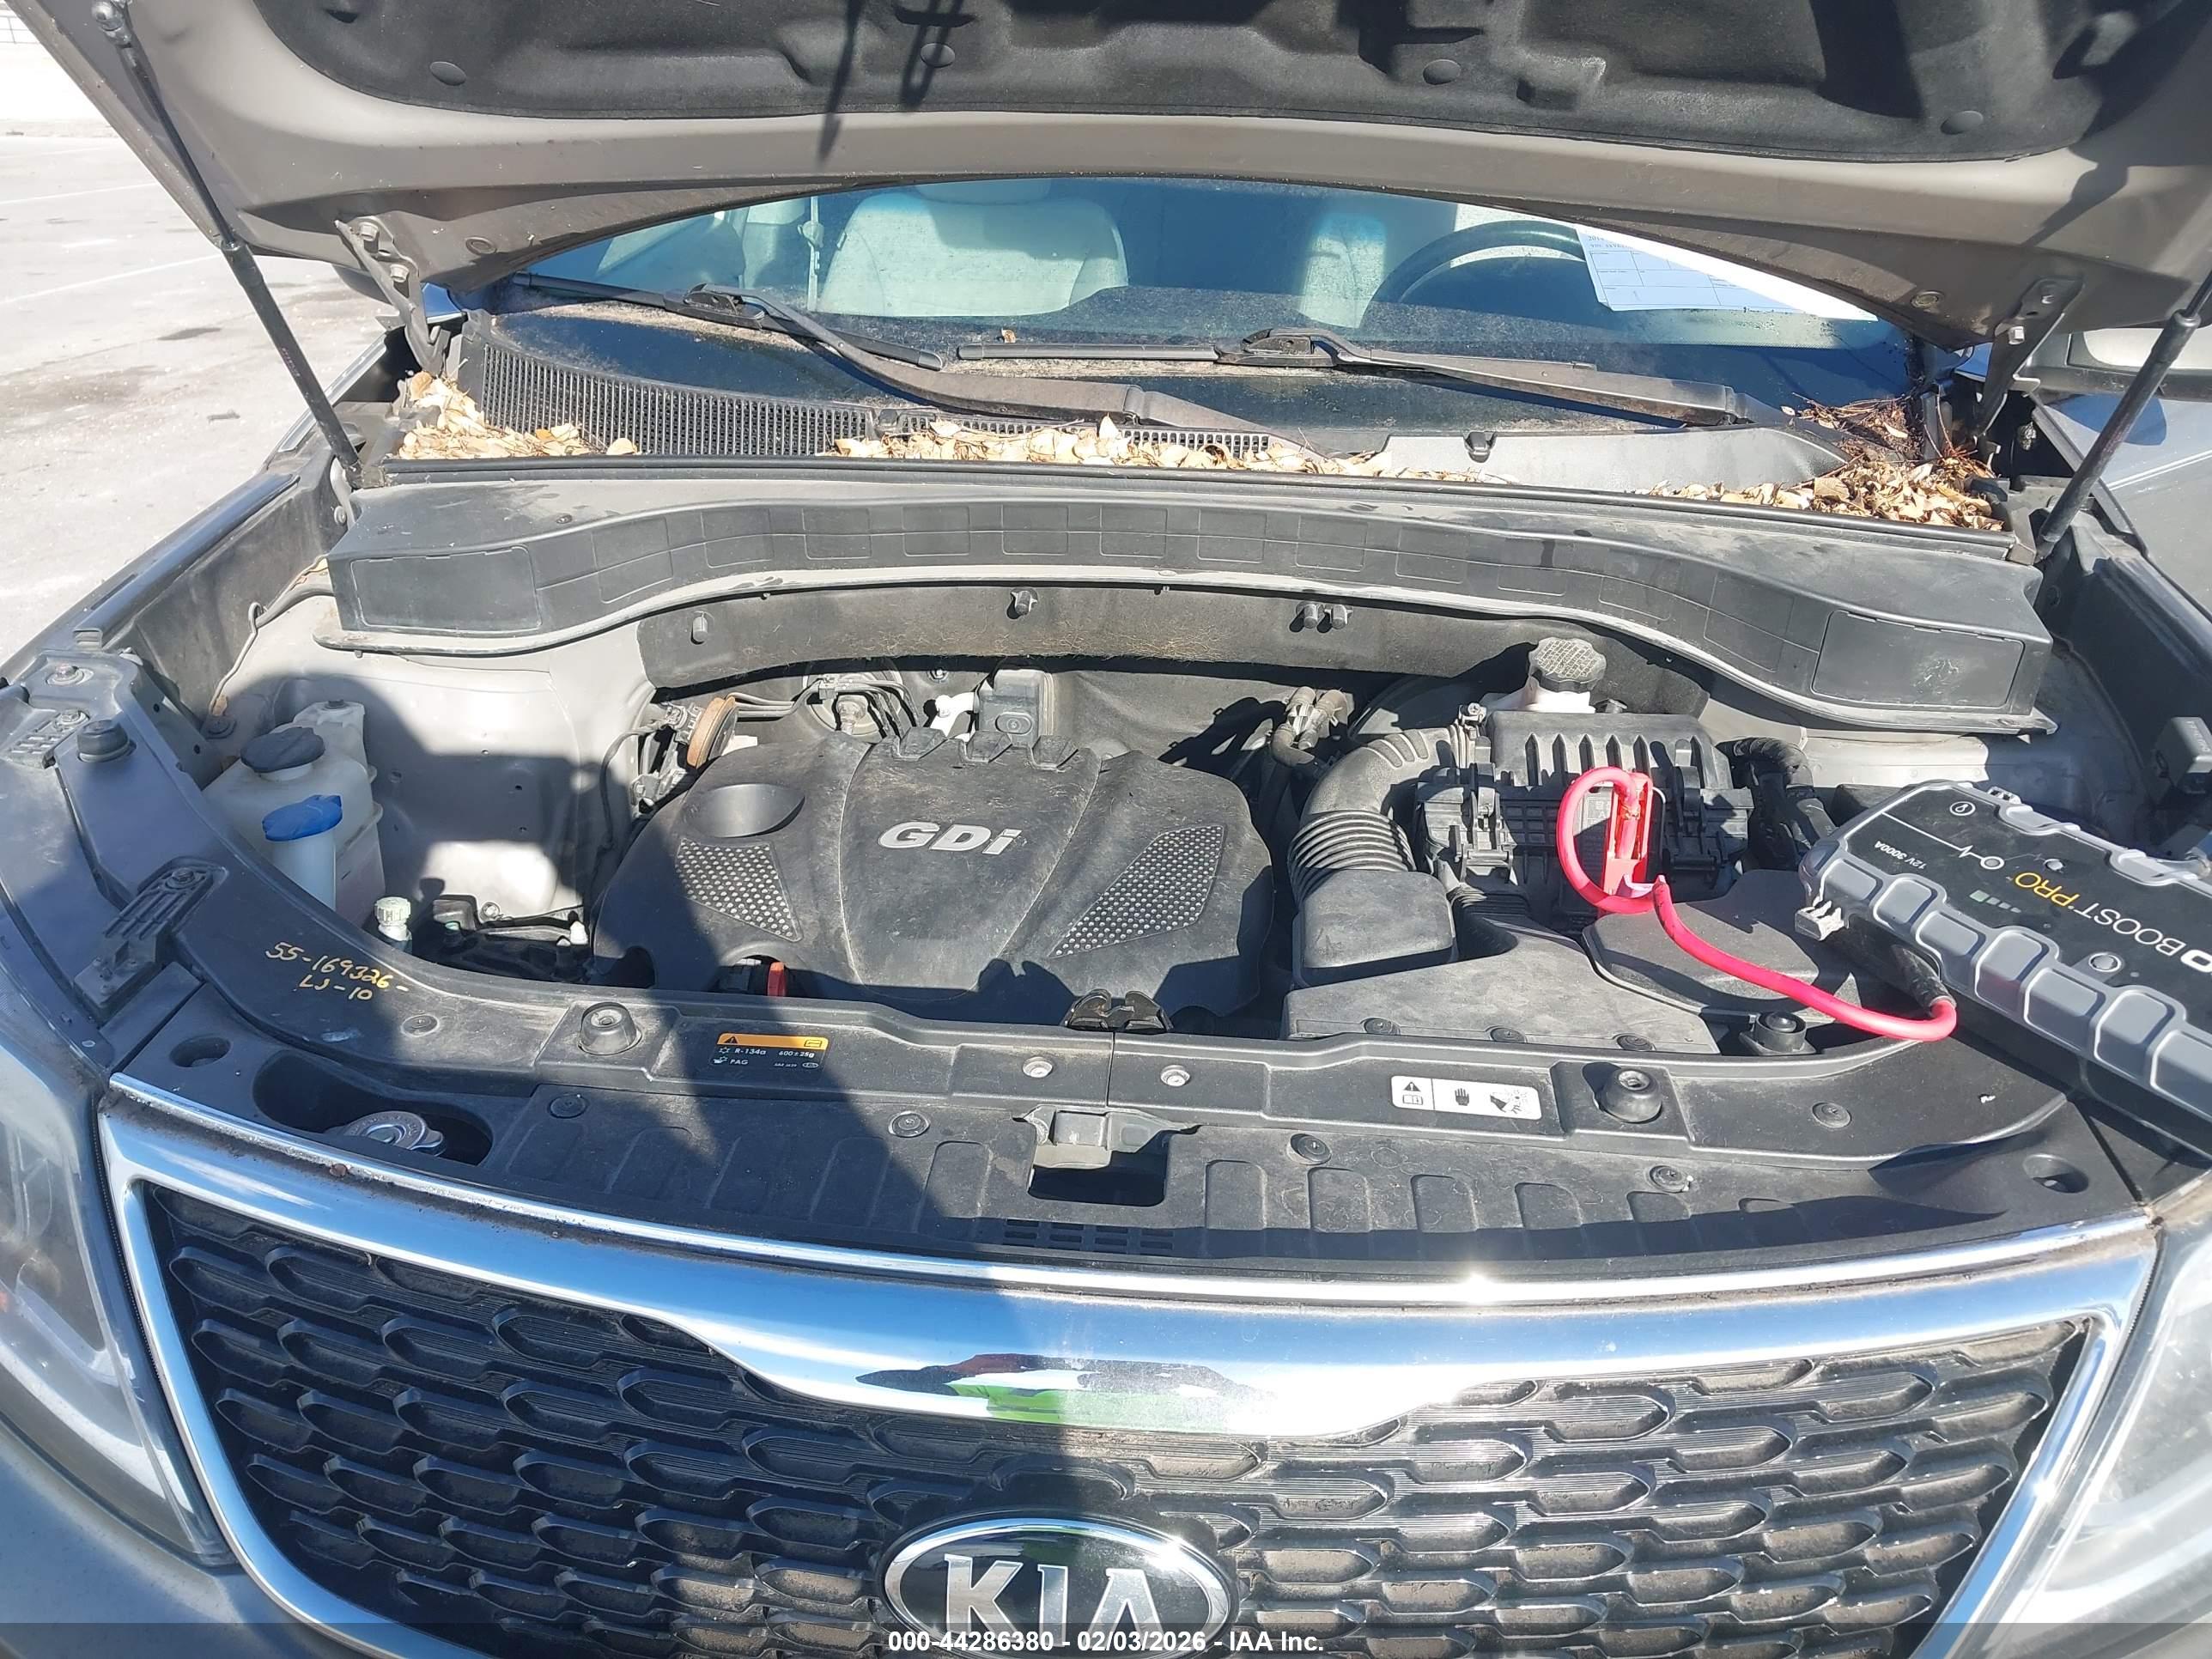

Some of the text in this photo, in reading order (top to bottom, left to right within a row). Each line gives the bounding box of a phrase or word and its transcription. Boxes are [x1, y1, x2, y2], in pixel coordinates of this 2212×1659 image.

[878, 822, 1023, 855] GDi
[1875, 841, 1927, 869] 12V 3000A
[2014, 872, 2186, 957] BOOST PRO
[945, 1554, 1165, 1647] KIA
